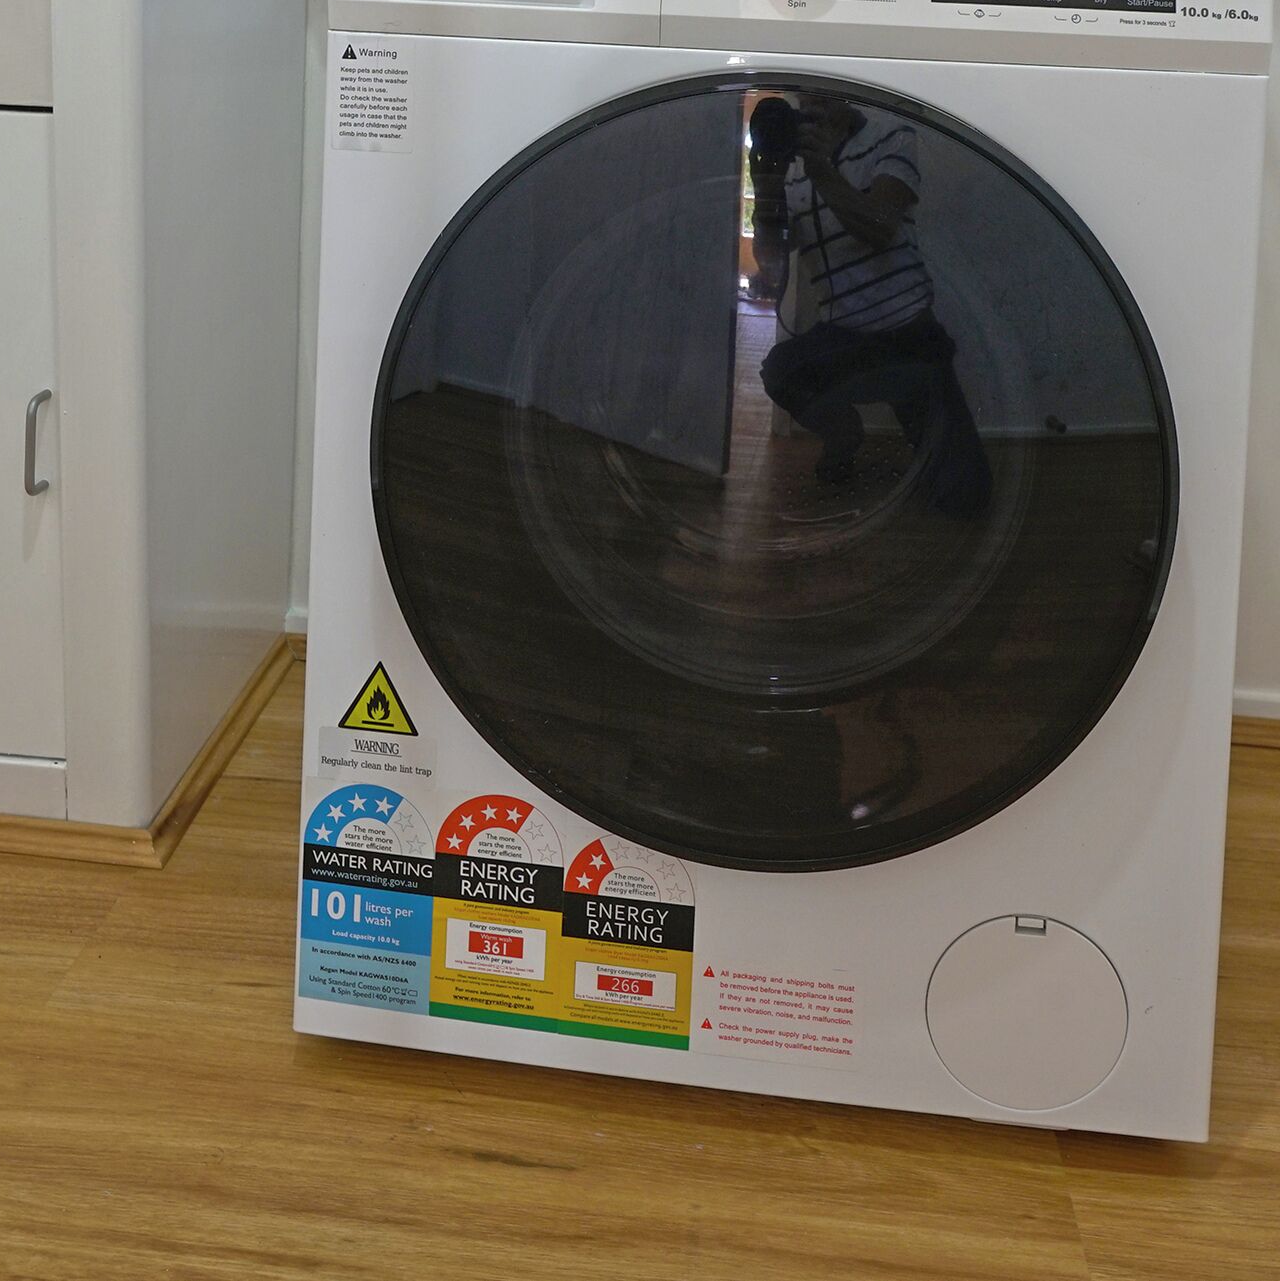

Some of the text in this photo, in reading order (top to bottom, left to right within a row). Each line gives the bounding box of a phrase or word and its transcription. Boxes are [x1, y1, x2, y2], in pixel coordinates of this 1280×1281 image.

[788, 0, 806, 8] Spin
[1181, 7, 1209, 17] 10.0
[359, 48, 397, 59] Warning
[354, 739, 399, 755] WARNING
[321, 756, 432, 777] Regularly clean the lint trap
[354, 825, 366, 833] The
[345, 832, 360, 840] stars
[486, 833, 498, 841] The
[366, 843, 392, 852] efficient
[494, 842, 504, 850] the
[499, 850, 522, 859] efficient
[313, 850, 433, 878] WATER RATING
[311, 867, 418, 888] www.waterrating.gov.au
[460, 860, 538, 885] ENERGY
[461, 880, 535, 904] RATING
[605, 887, 656, 897] energy efficient
[365, 901, 414, 918] litres per
[586, 901, 669, 925] ENERGY
[364, 917, 391, 927] wash
[469, 922, 523, 934] Energy consumption
[332, 929, 348, 938] Load
[349, 933, 375, 942] capacity
[392, 938, 400, 946] kg
[588, 920, 663, 944] RATING
[483, 940, 507, 955] 361
[320, 948, 356, 959] accordance
[357, 953, 371, 961] with
[596, 966, 656, 978] Energy consumption
[611, 978, 640, 993] 266
[733, 973, 767, 983] packaging
[787, 979, 814, 988] shipping
[730, 984, 759, 992] removed
[619, 993, 629, 1001] per
[743, 1038, 773, 1046] grounded
[784, 1043, 812, 1051] qualified
